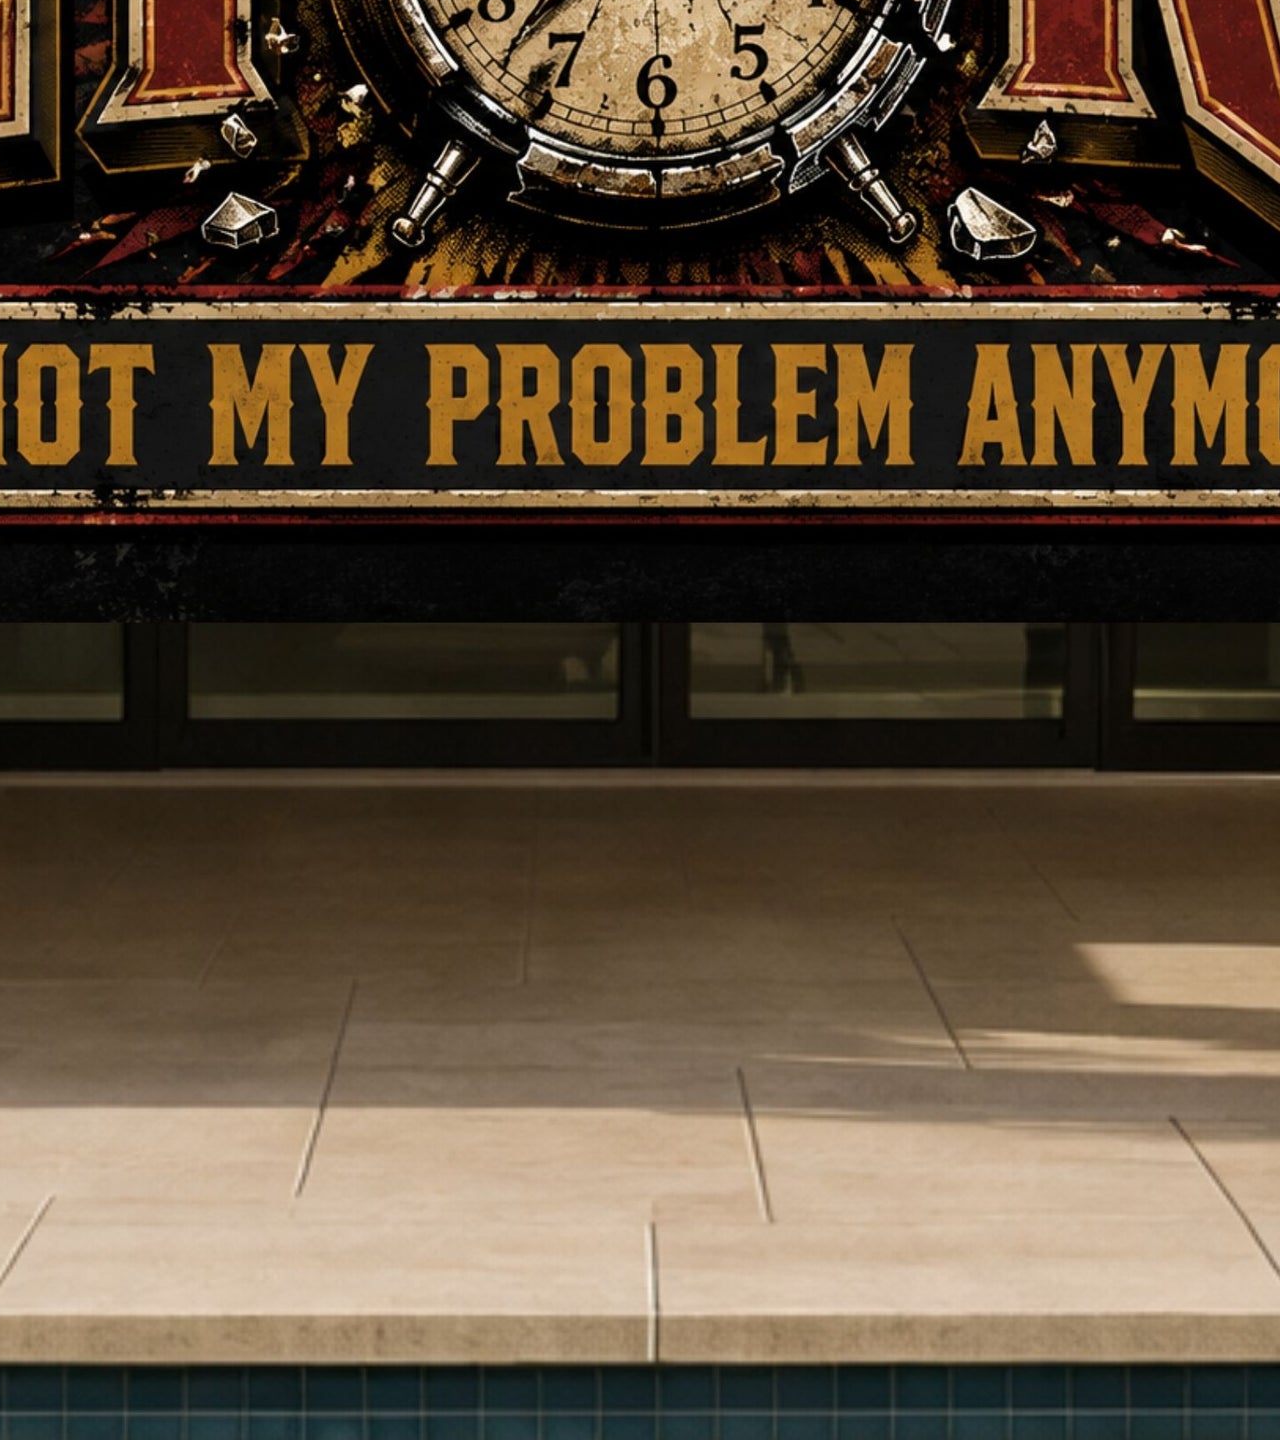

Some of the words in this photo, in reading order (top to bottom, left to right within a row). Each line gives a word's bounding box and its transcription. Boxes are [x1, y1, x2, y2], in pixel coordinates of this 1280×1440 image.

[547, 30, 587, 89] 7
[729, 22, 769, 81] 5
[635, 53, 678, 111] 6
[206, 342, 375, 468] MY
[425, 342, 915, 468] PROBLEM
